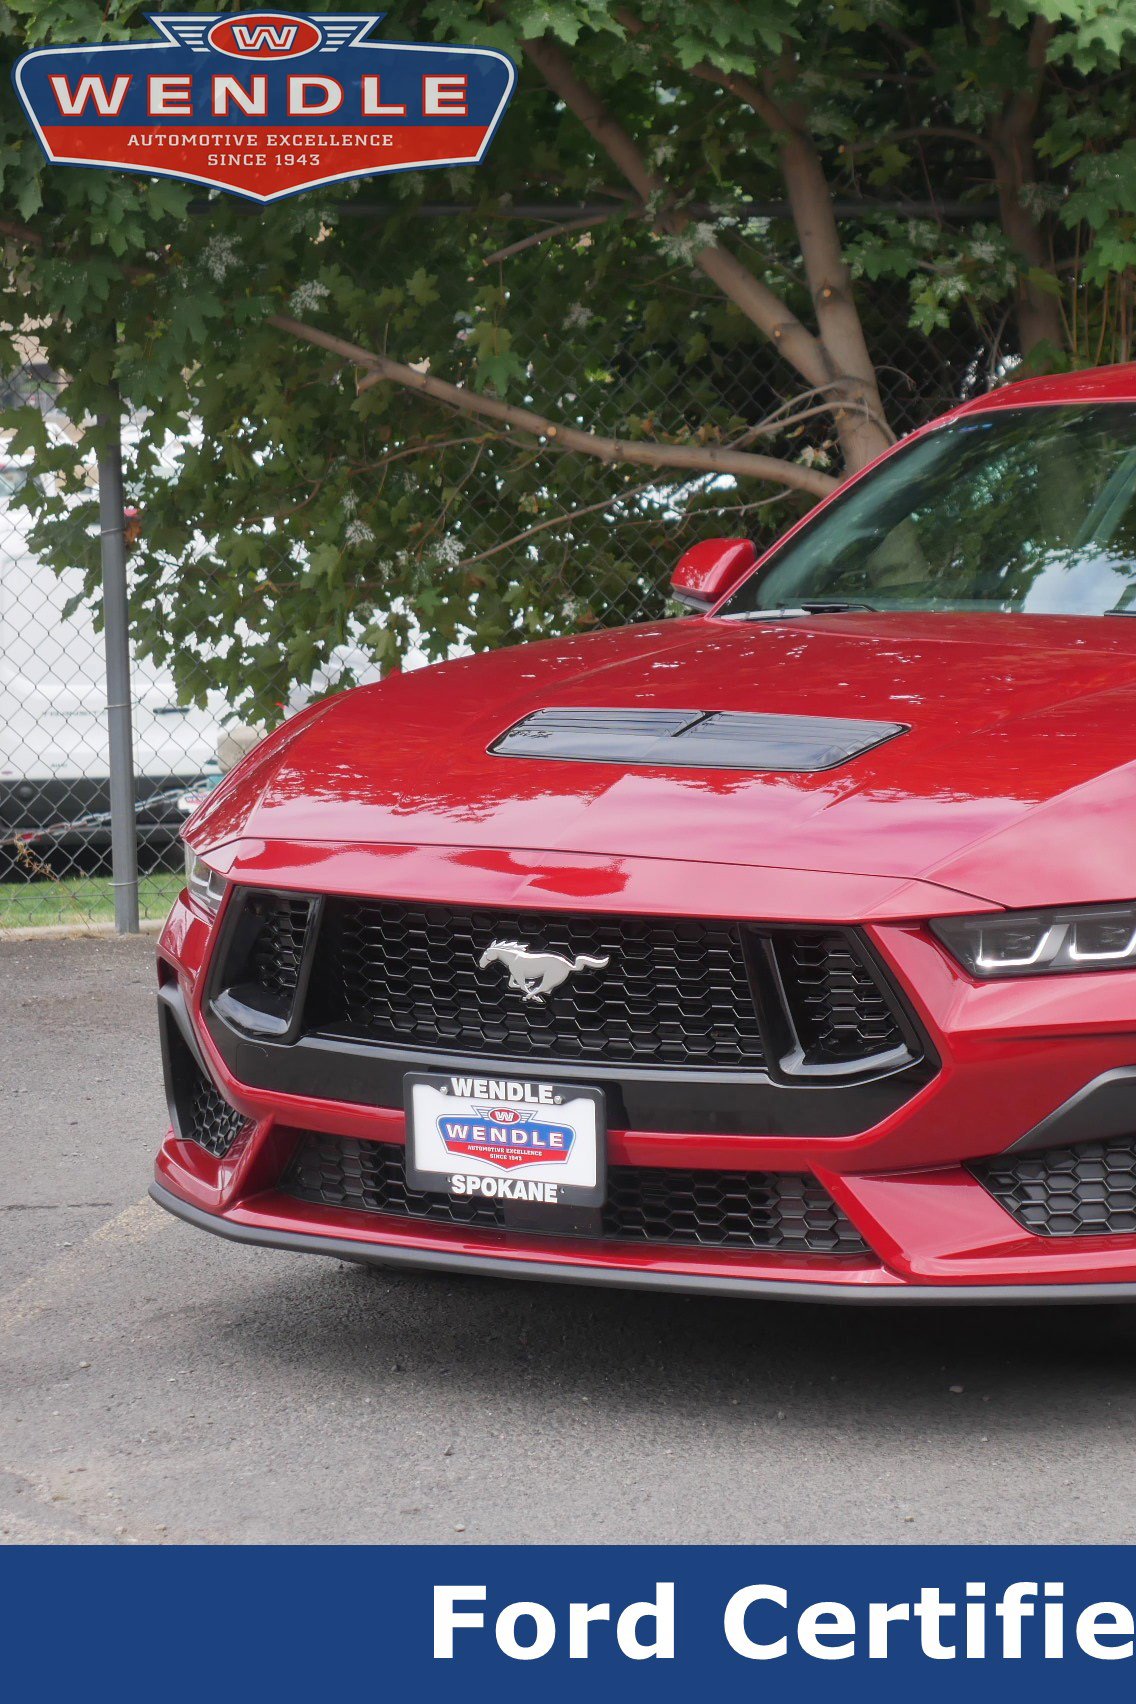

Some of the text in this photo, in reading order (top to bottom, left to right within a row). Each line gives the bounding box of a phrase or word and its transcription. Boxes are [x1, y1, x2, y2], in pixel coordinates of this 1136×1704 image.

[451, 1077, 553, 1104] WENDLE
[446, 1124, 564, 1147] WENDLE
[467, 1144, 543, 1157] AUTOMOTIVE EXCELLENCE
[452, 1175, 558, 1203] SPOKANE
